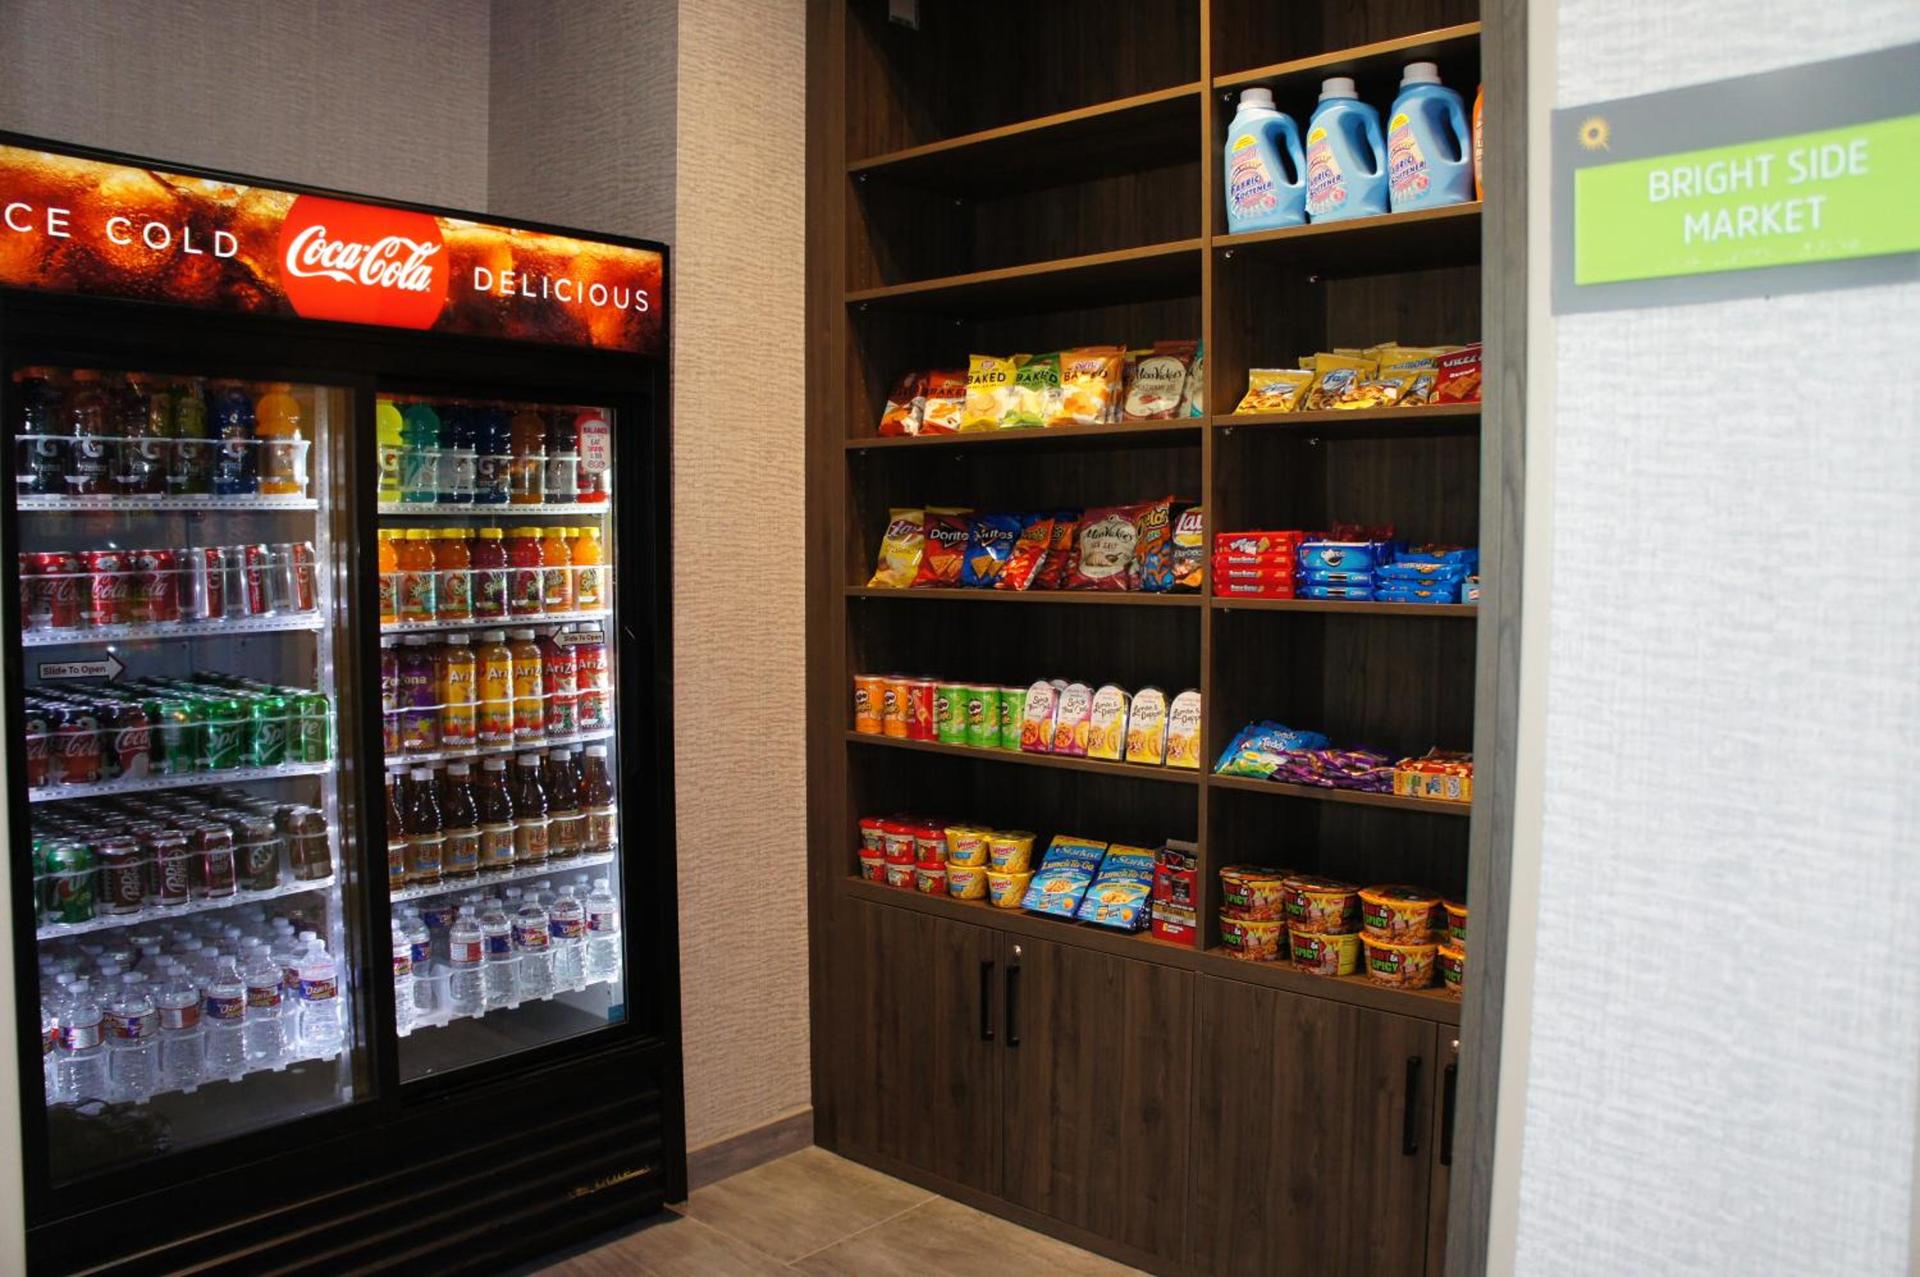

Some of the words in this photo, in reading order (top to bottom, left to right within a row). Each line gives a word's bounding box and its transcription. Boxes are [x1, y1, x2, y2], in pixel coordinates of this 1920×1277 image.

[1648, 153, 1775, 203] BRIGHT
[1787, 138, 1869, 185] SIDE
[4, 201, 71, 238] CE
[105, 216, 239, 259] COLD
[1682, 195, 1827, 244] MARKET
[285, 224, 442, 293] Coca-Cola
[473, 266, 650, 312] DELICIOUS
[967, 371, 1006, 385] BAKED
[929, 528, 969, 542] Dorito
[43, 666, 67, 676] Slide
[68, 666, 80, 674] To
[80, 664, 106, 675] Open
[1371, 959, 1399, 973] SPICY
